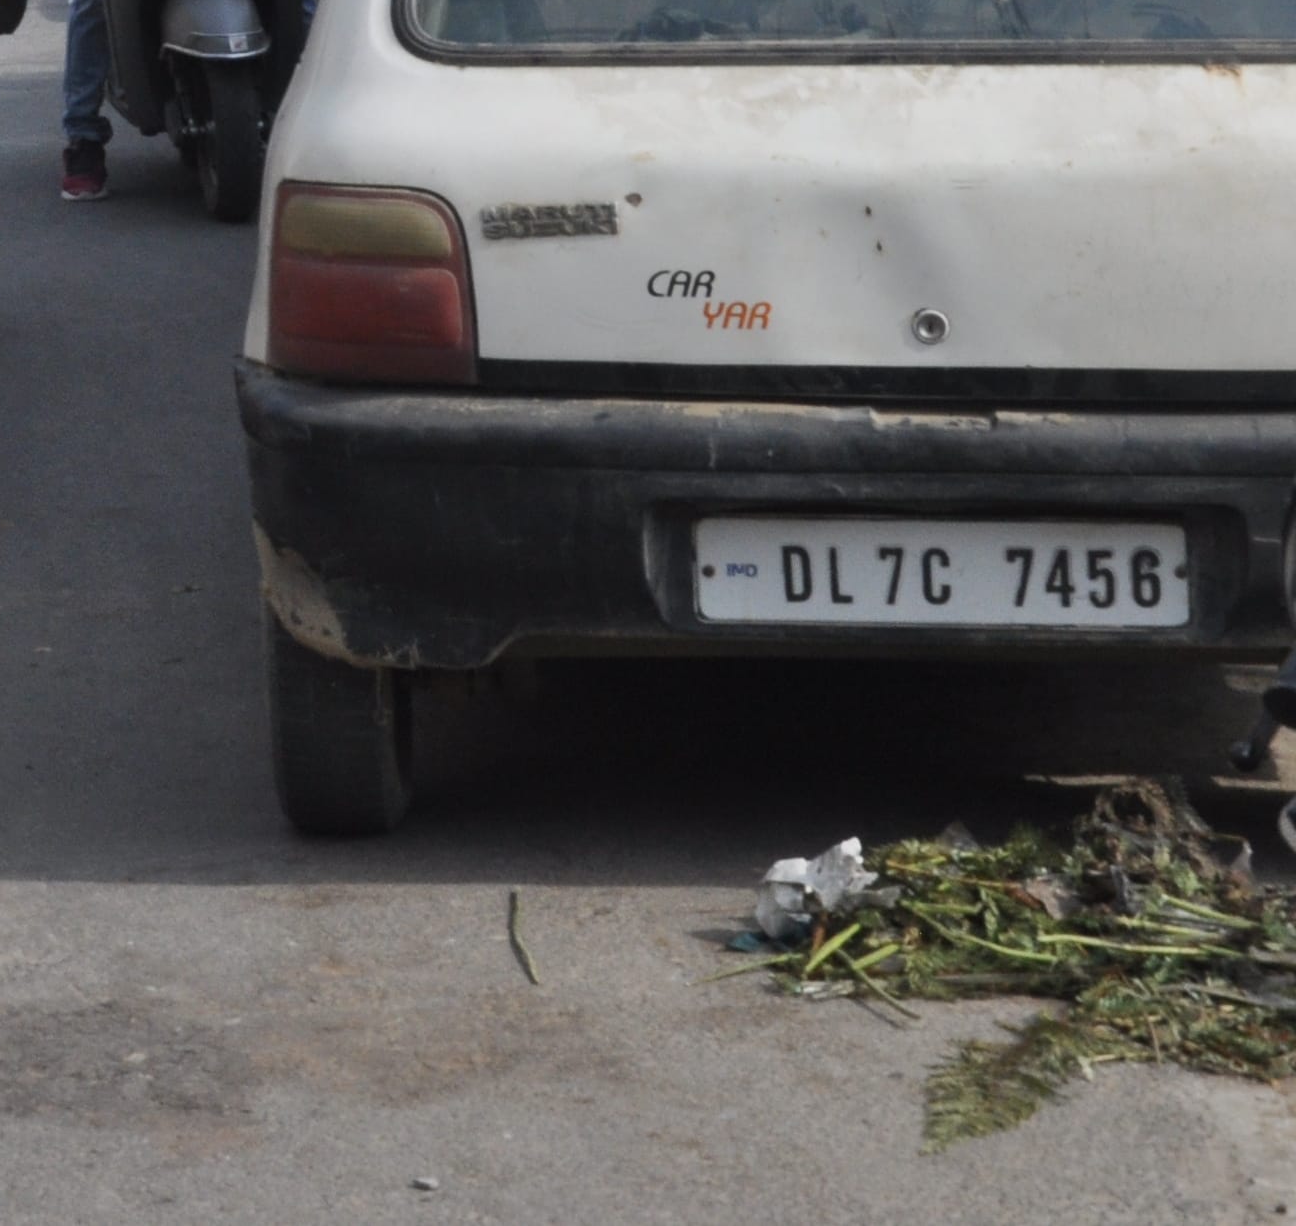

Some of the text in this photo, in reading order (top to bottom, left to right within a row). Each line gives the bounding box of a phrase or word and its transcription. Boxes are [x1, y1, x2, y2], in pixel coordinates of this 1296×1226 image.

[646, 269, 716, 298] CAR
[702, 301, 773, 330] YAR
[1004, 546, 1164, 609] 7456
